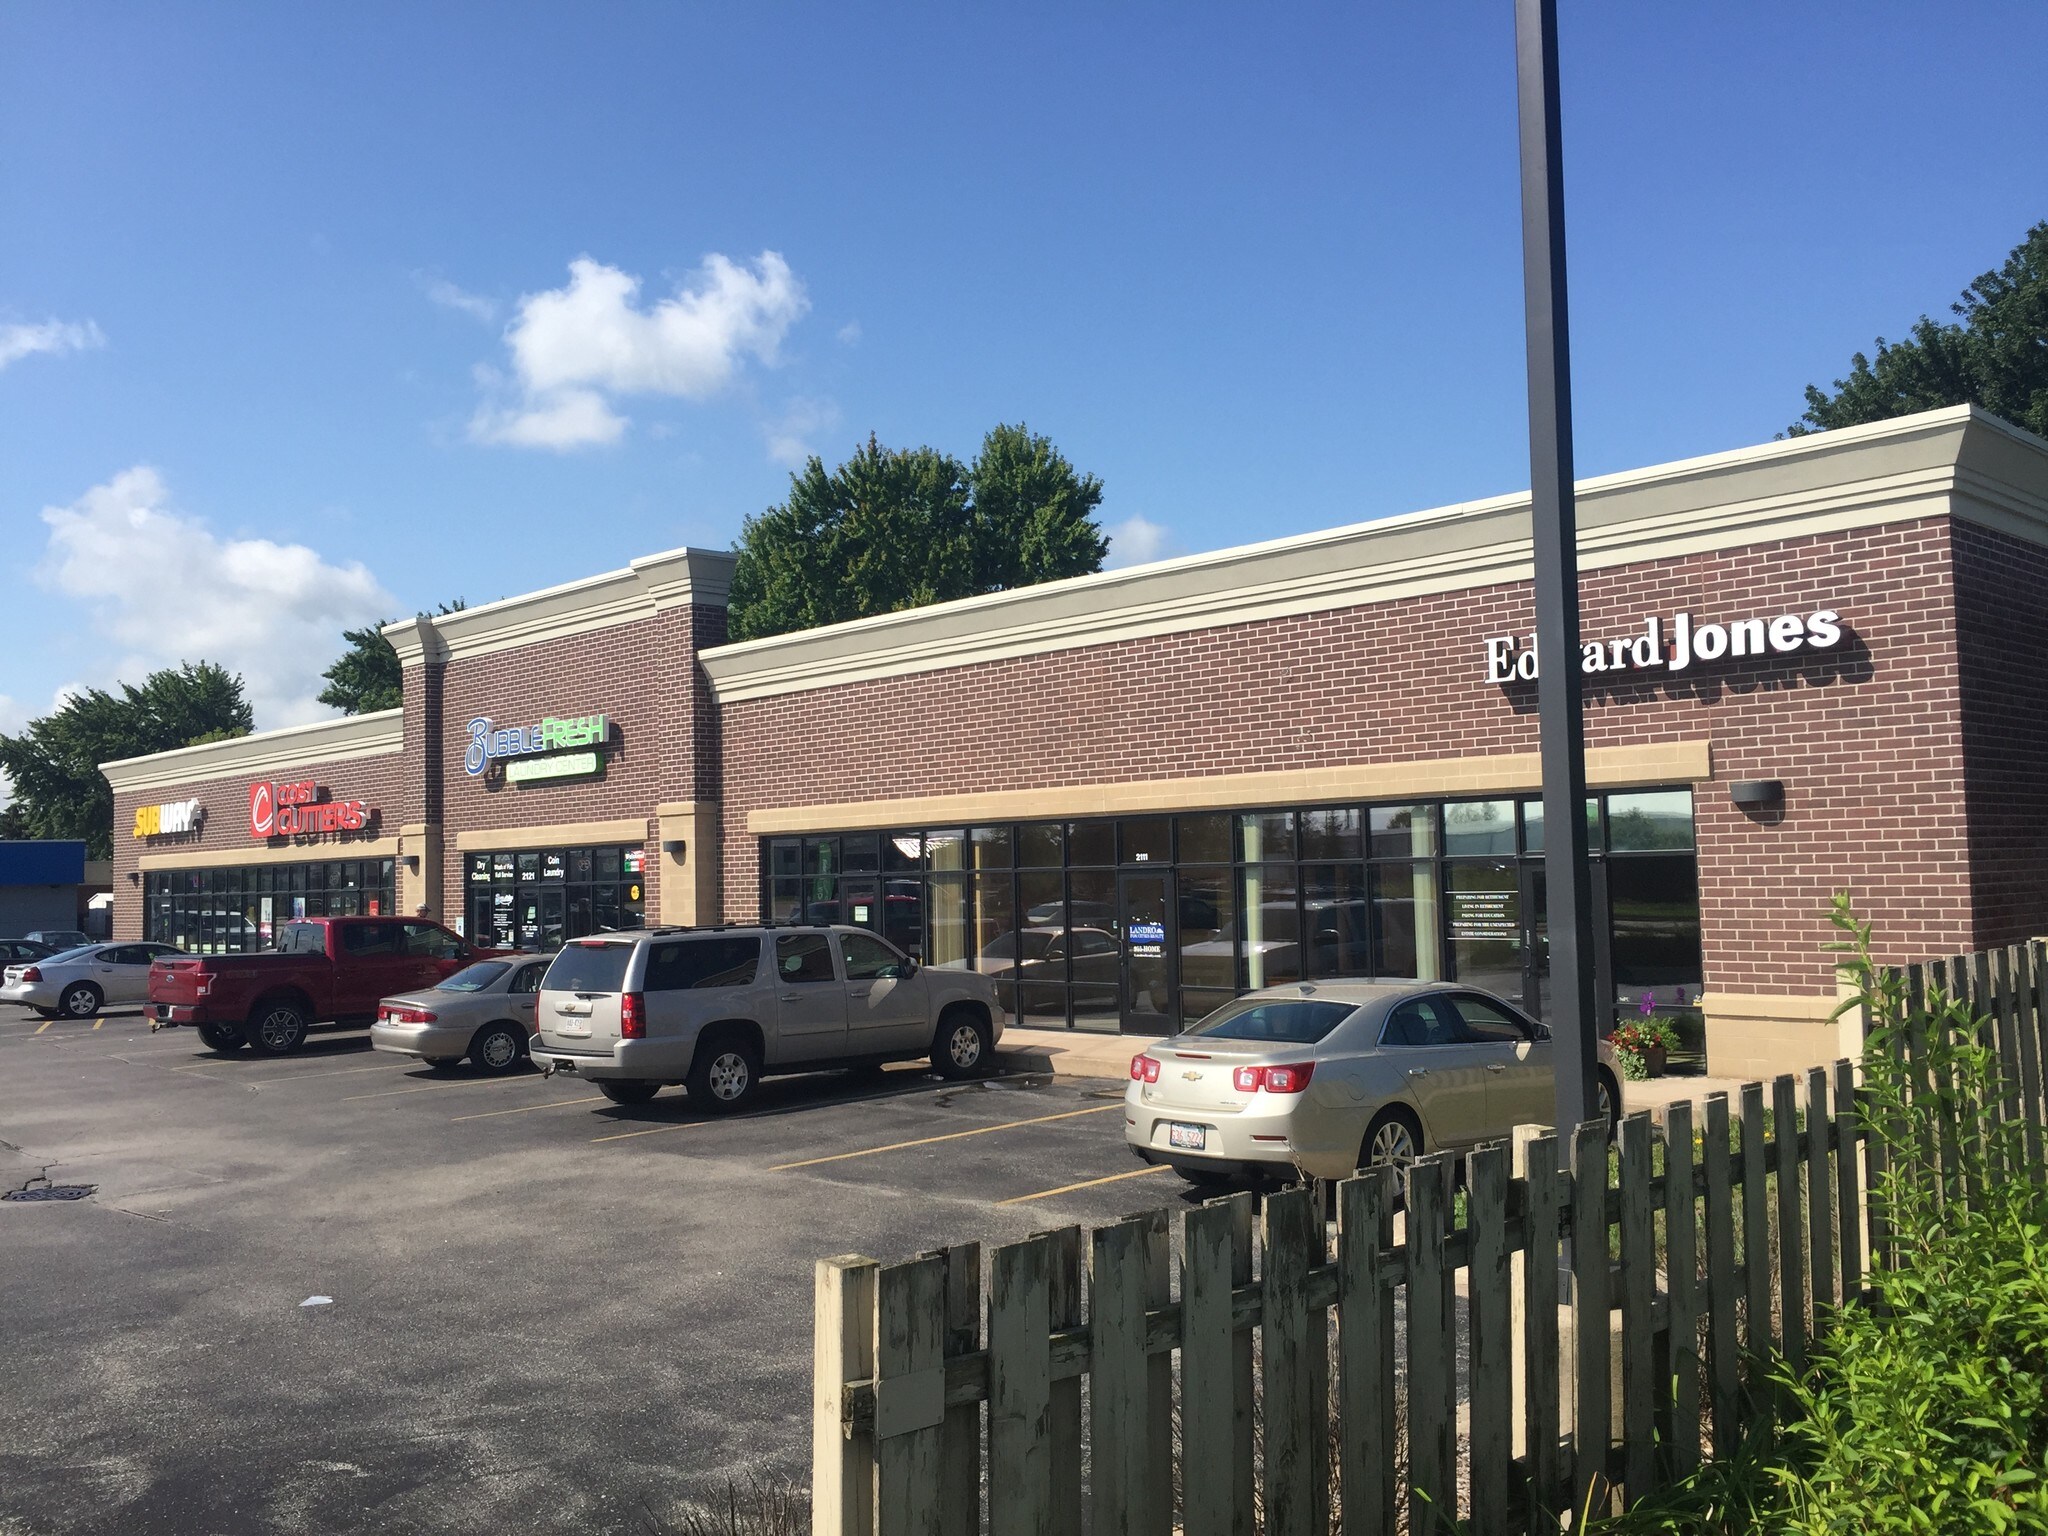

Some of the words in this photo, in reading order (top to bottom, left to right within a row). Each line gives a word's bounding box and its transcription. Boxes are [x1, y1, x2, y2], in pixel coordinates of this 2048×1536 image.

[1484, 616, 1663, 684] Edard
[1668, 610, 1842, 672] Jones
[508, 761, 554, 779] LAUNDRY
[555, 755, 595, 773] CENTER
[277, 781, 318, 806] COST
[133, 798, 201, 839] SUBWAY
[277, 801, 367, 836] CUTTERS
[547, 856, 560, 865] Coin
[476, 861, 486, 871] Dry
[471, 872, 491, 882] Cleaning
[521, 871, 535, 881] 2121
[543, 868, 565, 878] Laundry
[1129, 926, 1156, 934] LANDRO
